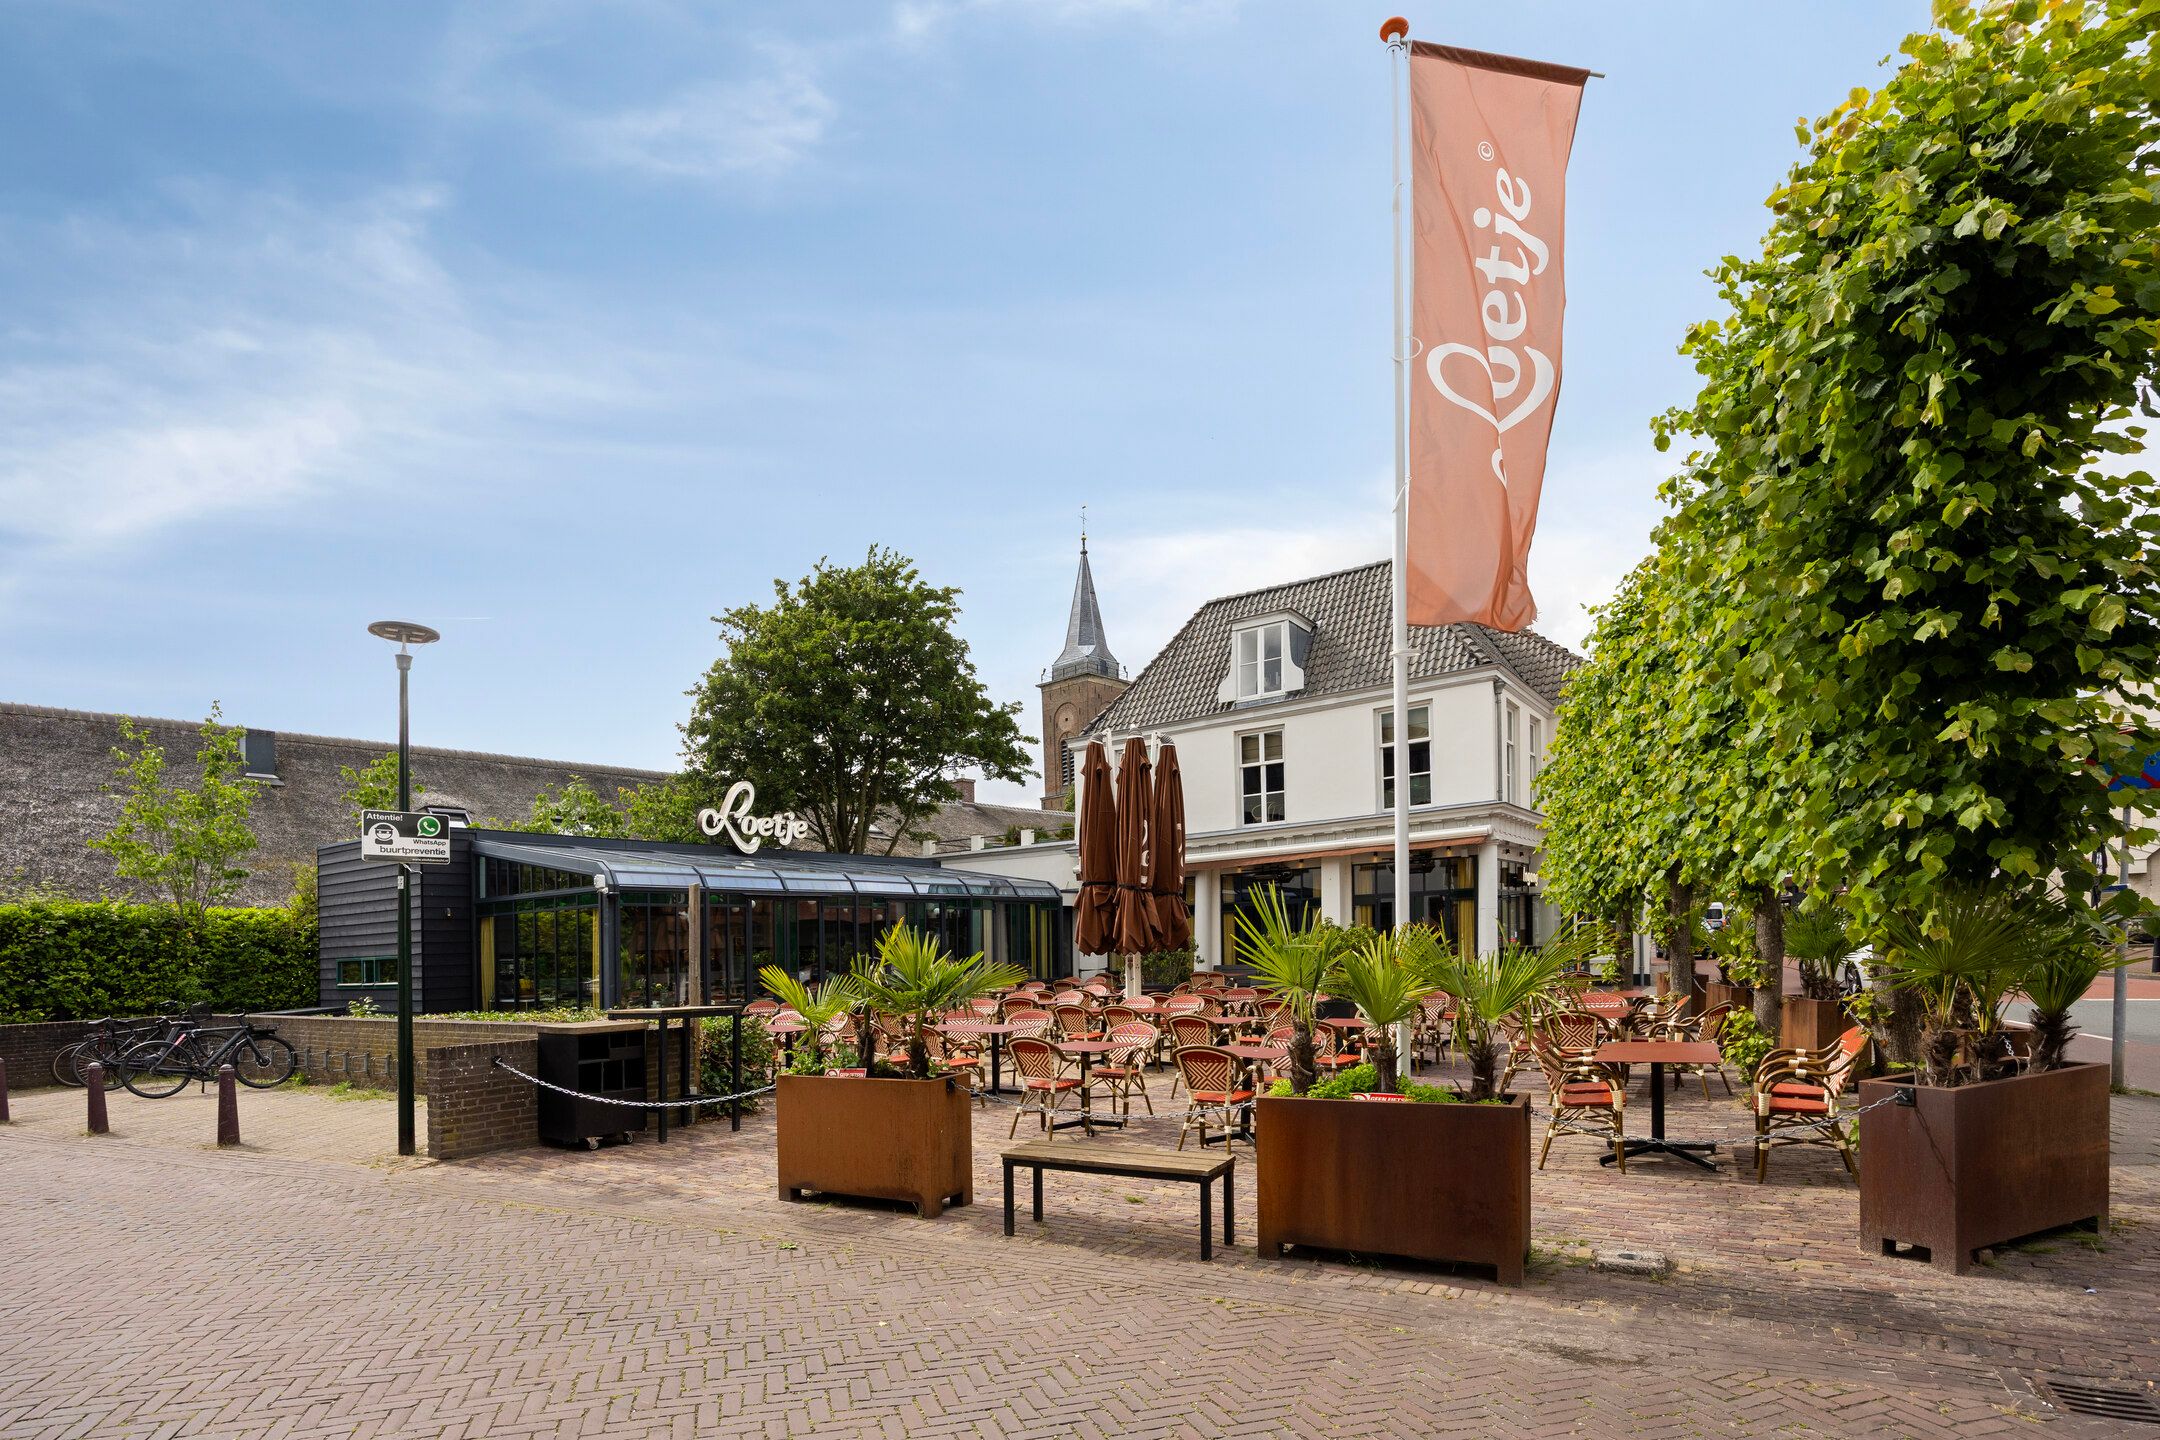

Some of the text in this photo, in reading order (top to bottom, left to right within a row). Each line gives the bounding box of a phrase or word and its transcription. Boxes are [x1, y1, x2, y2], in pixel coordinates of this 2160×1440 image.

[366, 813, 403, 821] Attentie!
[697, 780, 809, 854] Loetje
[379, 846, 446, 856] buurtpreventie
